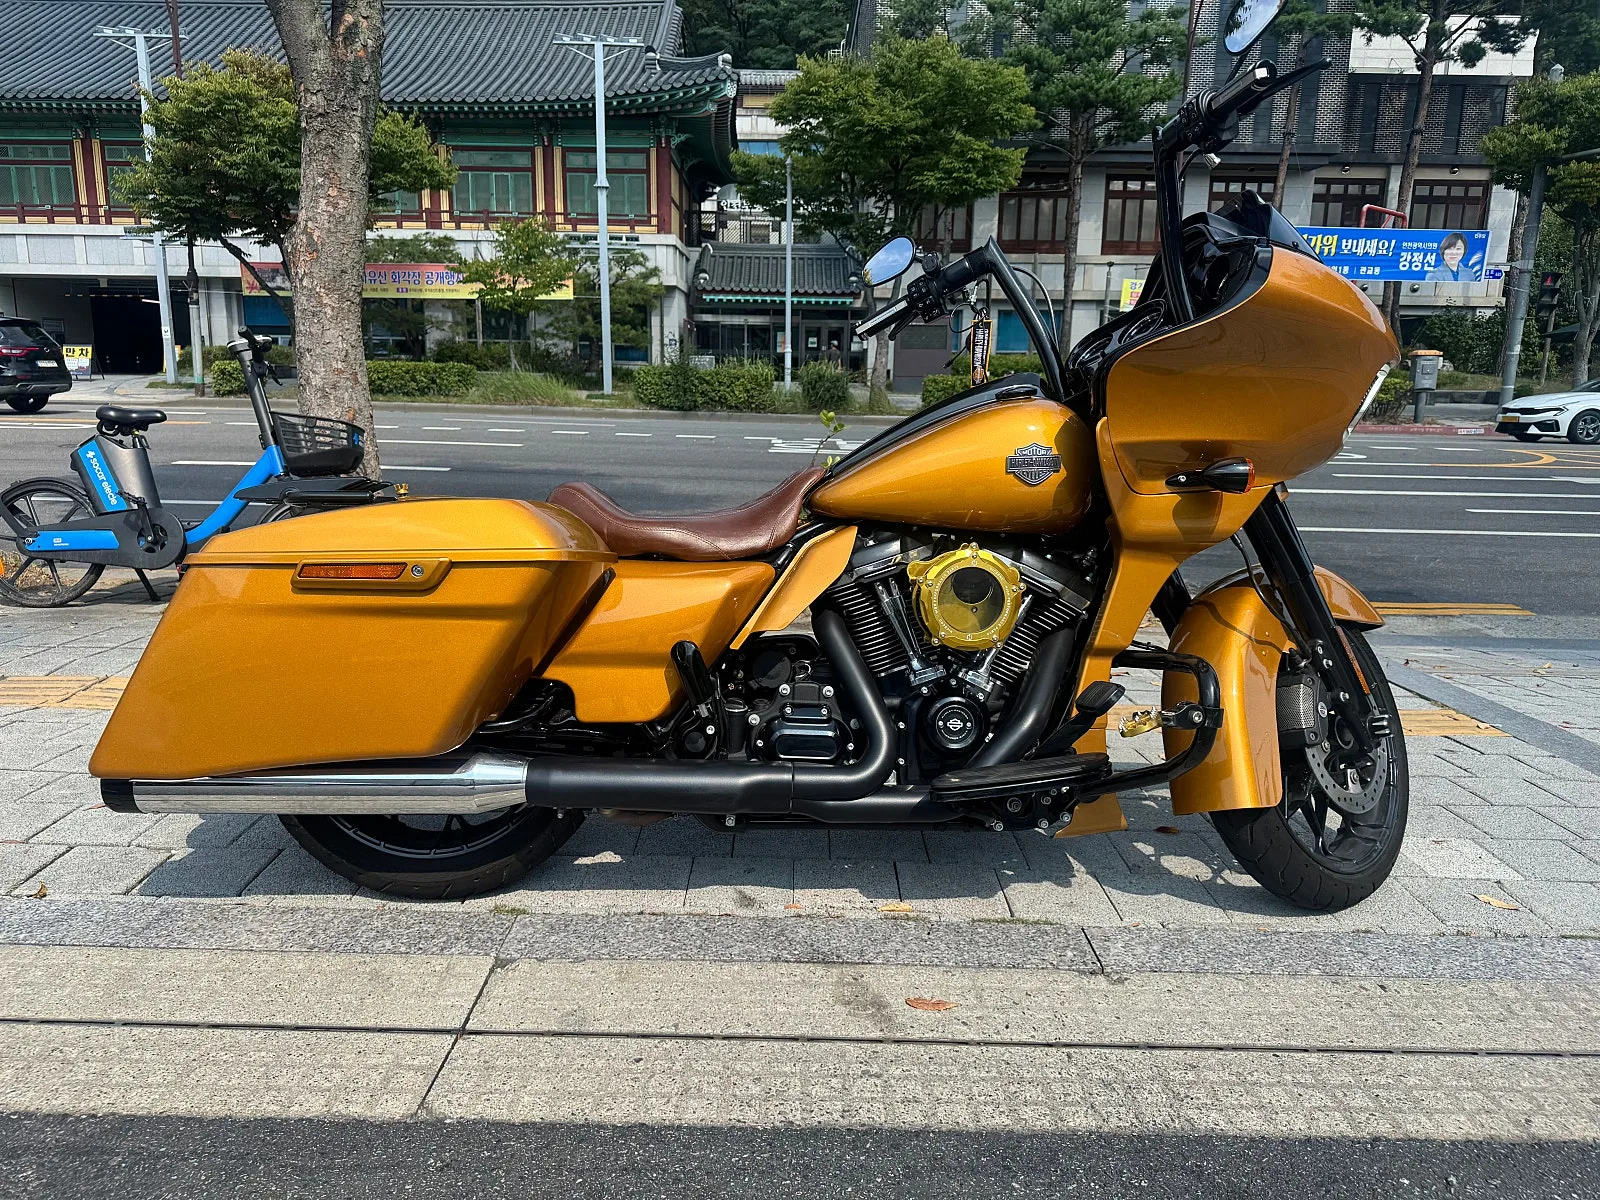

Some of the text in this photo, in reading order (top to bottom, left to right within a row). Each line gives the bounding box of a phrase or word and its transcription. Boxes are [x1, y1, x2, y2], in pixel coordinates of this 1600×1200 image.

[1302, 234, 1396, 256] 가위 보내세요!
[1399, 252, 1436, 271] 강정선
[391, 270, 421, 285] 화각장
[66, 347, 89, 358] 만 차
[90, 457, 118, 506] socar elecle
